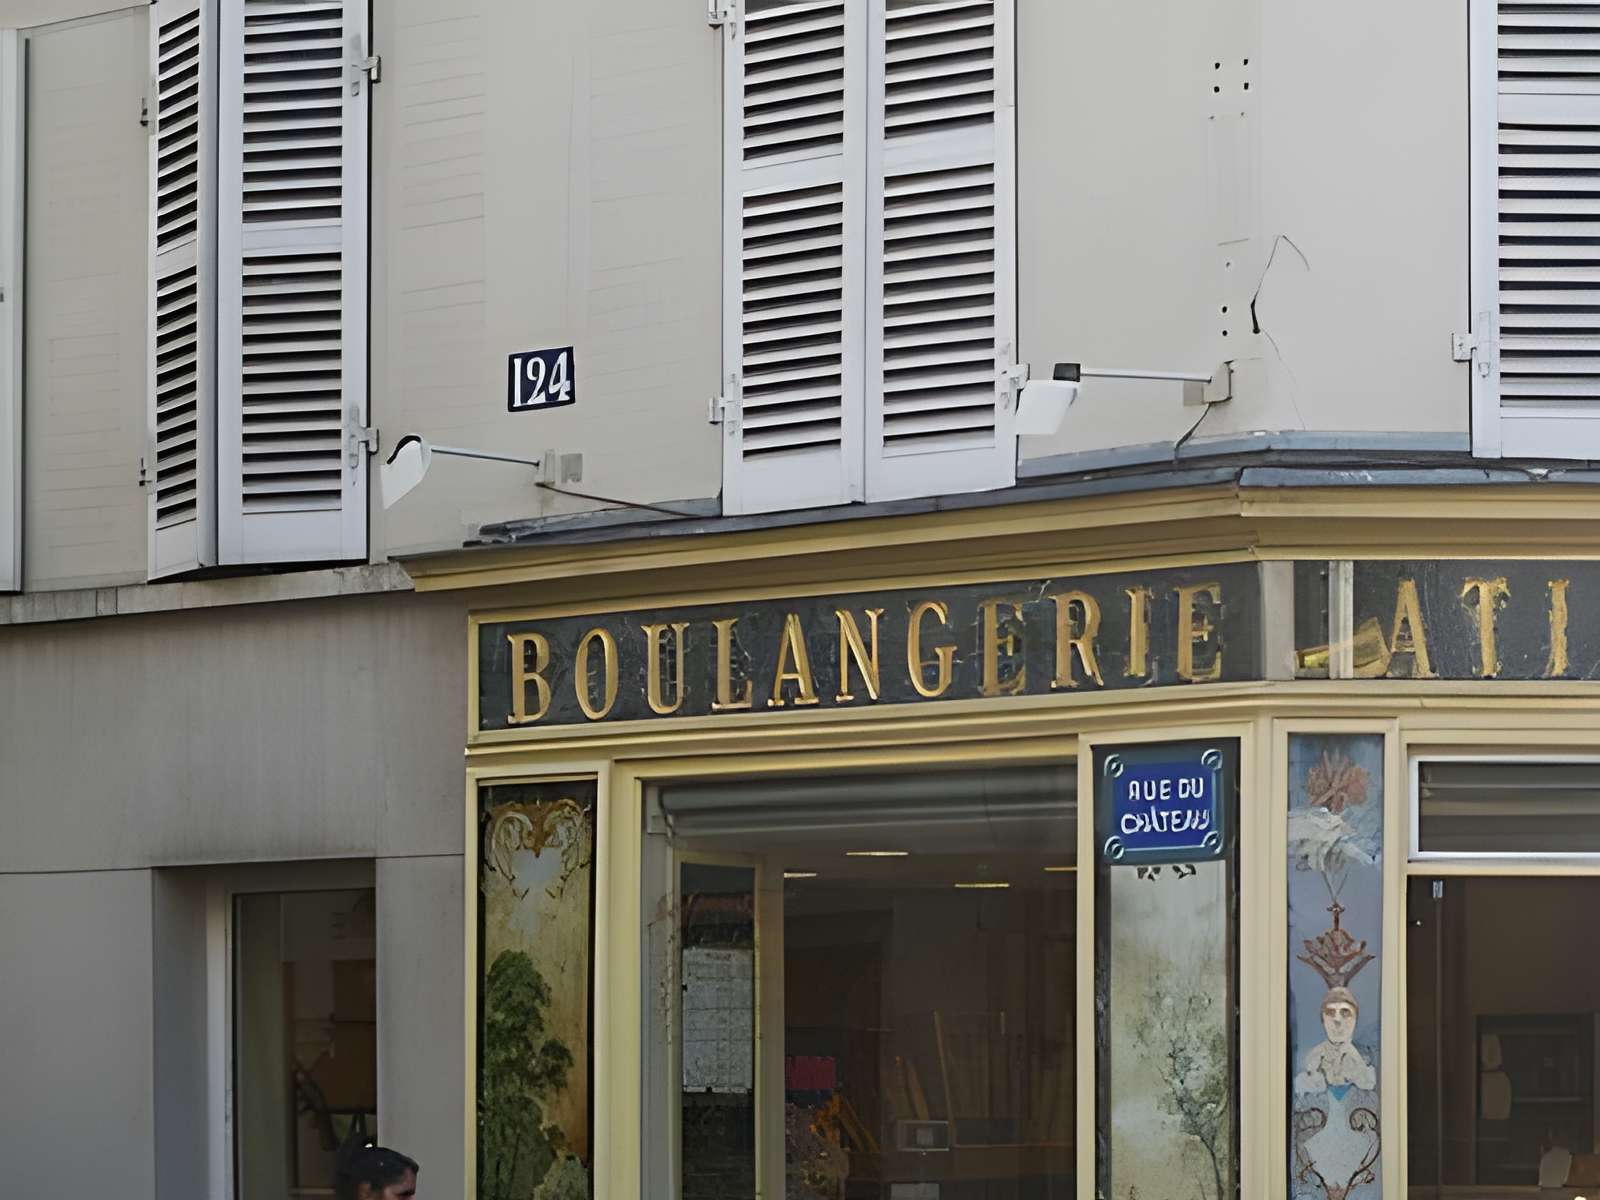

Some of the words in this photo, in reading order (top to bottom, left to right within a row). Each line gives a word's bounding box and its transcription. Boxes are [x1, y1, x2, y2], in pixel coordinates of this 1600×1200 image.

[512, 351, 571, 407] 124
[507, 581, 1224, 726] BOULANGERIE
[1128, 779, 1171, 801] RUE
[1178, 777, 1204, 799] DU
